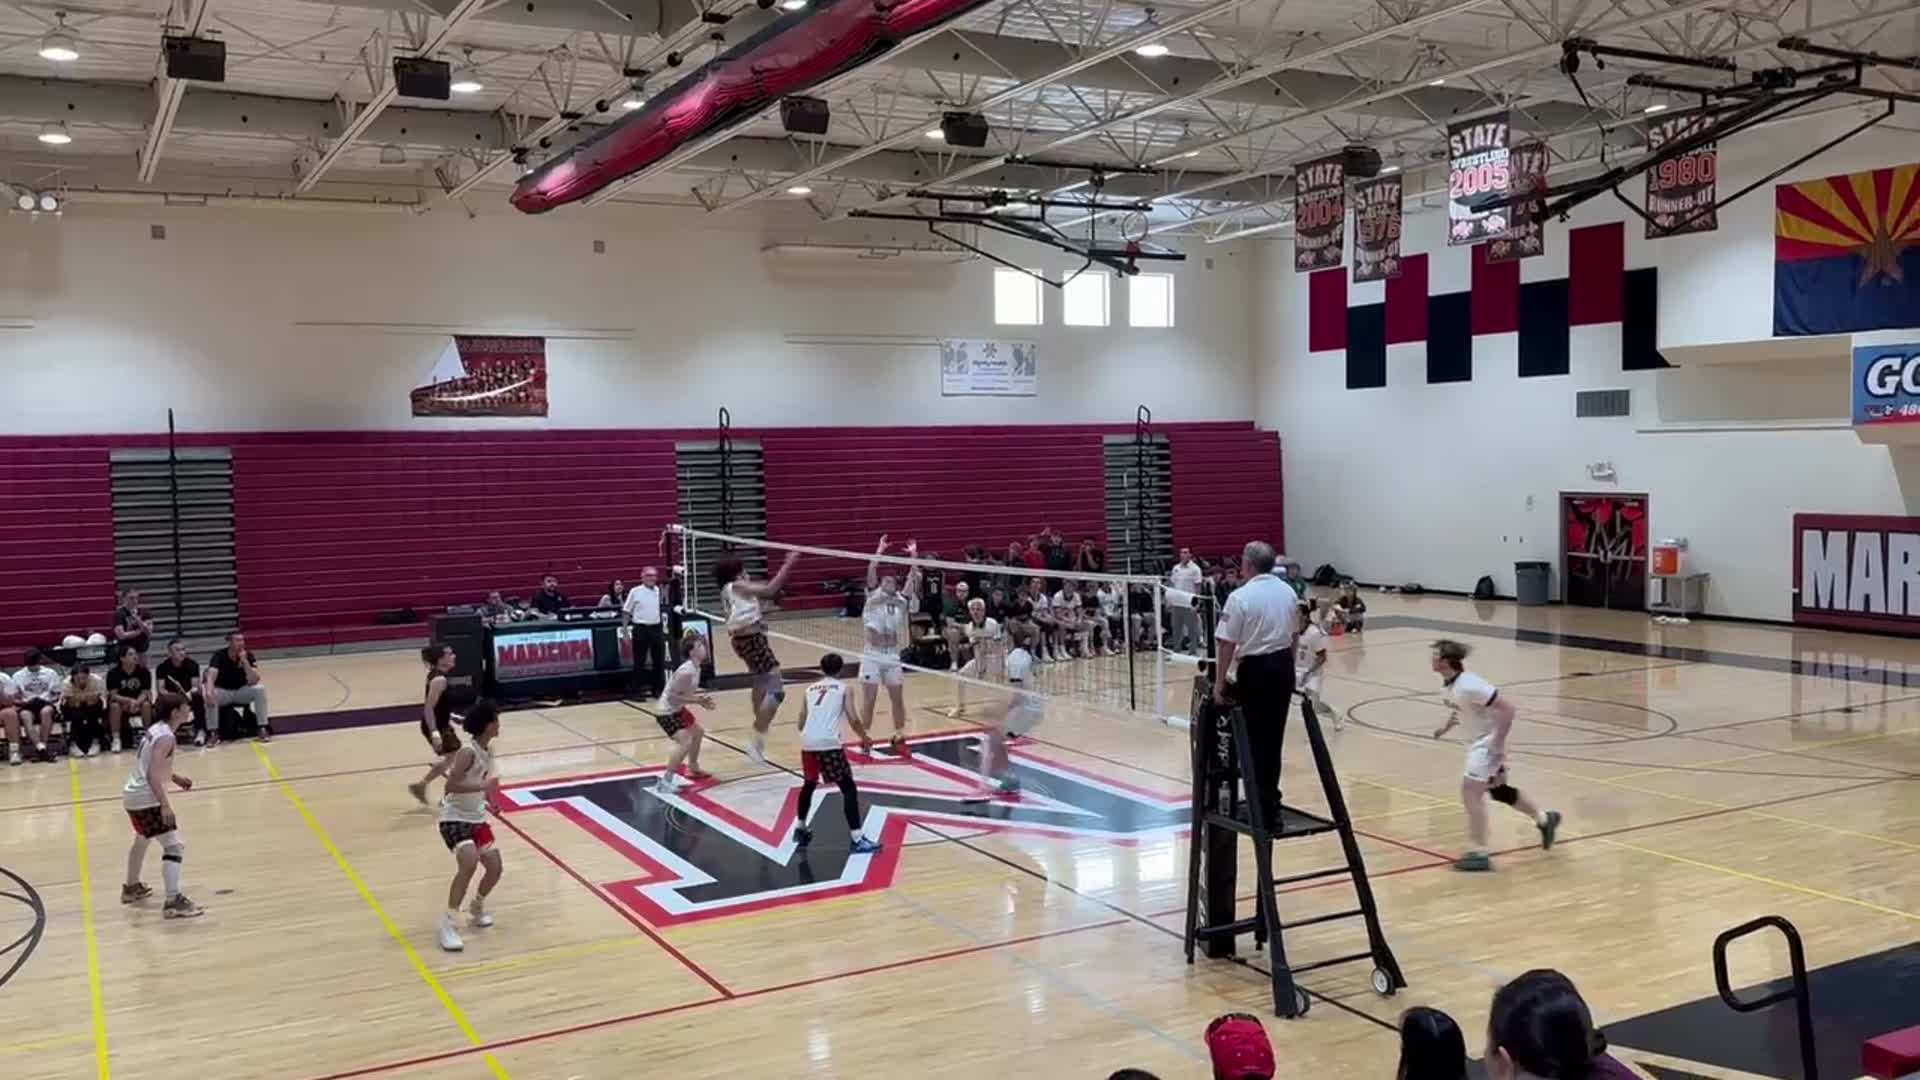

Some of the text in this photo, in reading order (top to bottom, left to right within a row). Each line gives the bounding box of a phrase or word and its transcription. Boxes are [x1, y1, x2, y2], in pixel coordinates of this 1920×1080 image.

[1450, 123, 1508, 157] STATE
[1297, 163, 1344, 193] STATE
[1450, 159, 1510, 199] 2005
[1649, 152, 1718, 191] 1980
[1356, 183, 1401, 210] STATE
[1296, 198, 1344, 231] 2004
[1801, 529, 1920, 617] MAR
[814, 688, 828, 706] 7
